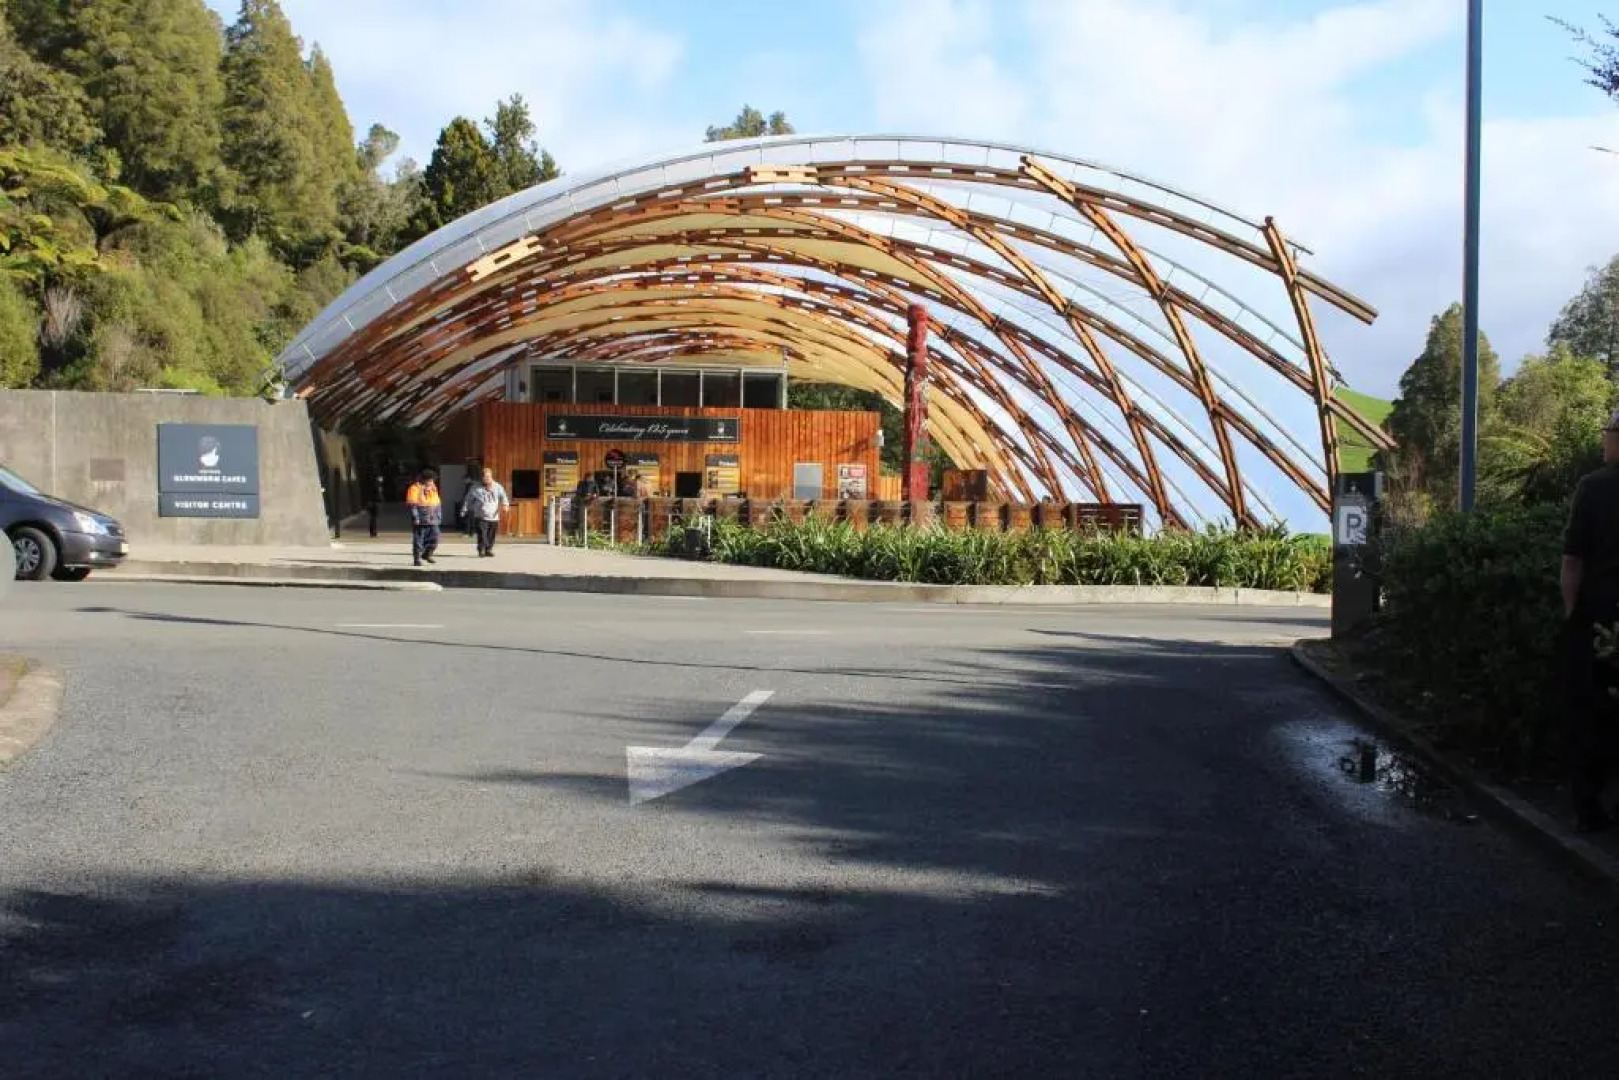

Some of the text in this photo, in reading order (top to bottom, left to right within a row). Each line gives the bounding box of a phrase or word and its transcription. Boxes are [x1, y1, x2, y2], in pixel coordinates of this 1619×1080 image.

[174, 500, 248, 510] VISITOR CENTRE
[1346, 513, 1362, 538] P
